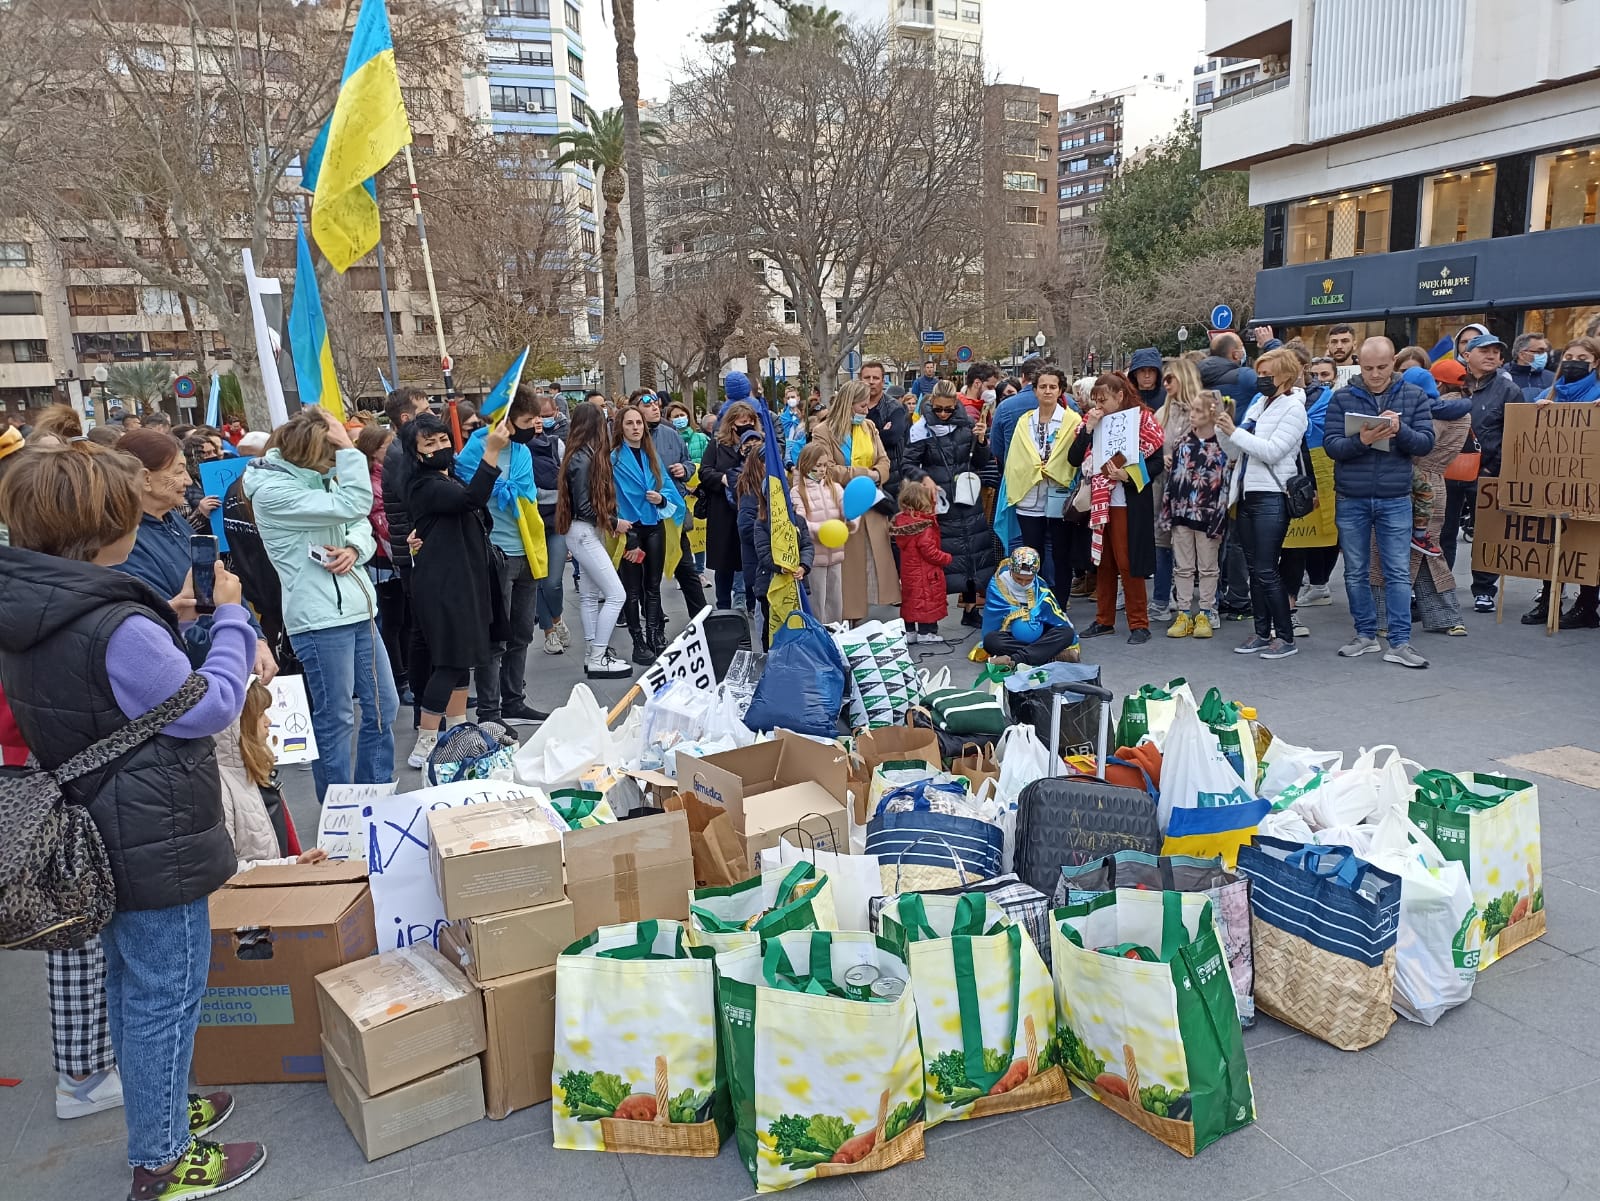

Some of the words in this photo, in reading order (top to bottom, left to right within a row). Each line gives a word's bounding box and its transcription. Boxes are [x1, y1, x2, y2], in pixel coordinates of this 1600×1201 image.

[1311, 294, 1344, 306] ROLEX
[1536, 408, 1591, 428] PUTIN
[1521, 429, 1600, 455] NADIE
[1529, 456, 1592, 480] QUIERE
[1506, 481, 1533, 504] TU
[1545, 481, 1600, 510] GUER
[1504, 514, 1567, 546] HELP
[1482, 542, 1588, 580] UKRAINE
[216, 1012, 258, 1025] (8x10)
